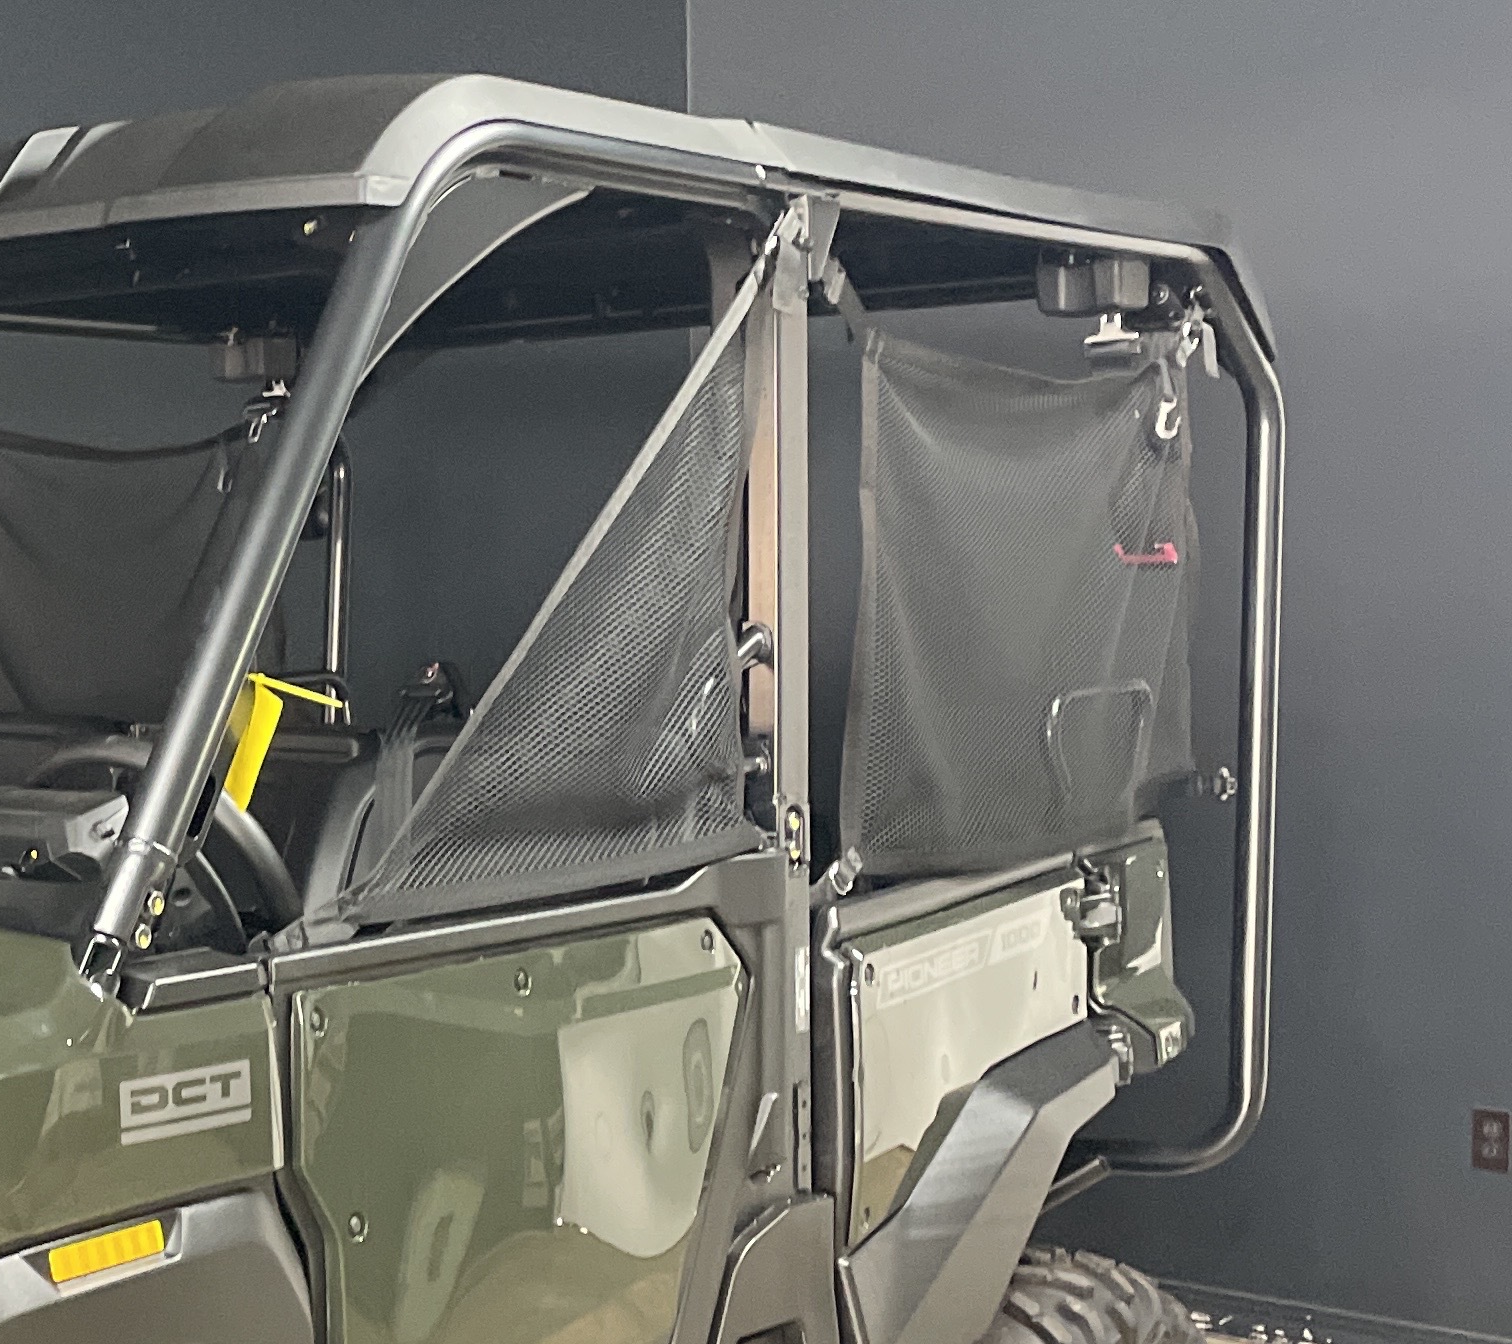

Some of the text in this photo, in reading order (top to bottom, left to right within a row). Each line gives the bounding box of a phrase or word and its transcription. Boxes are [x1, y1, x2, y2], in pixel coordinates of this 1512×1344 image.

[887, 917, 1044, 996] PIONEER 1000
[130, 1070, 242, 1116] DCT
